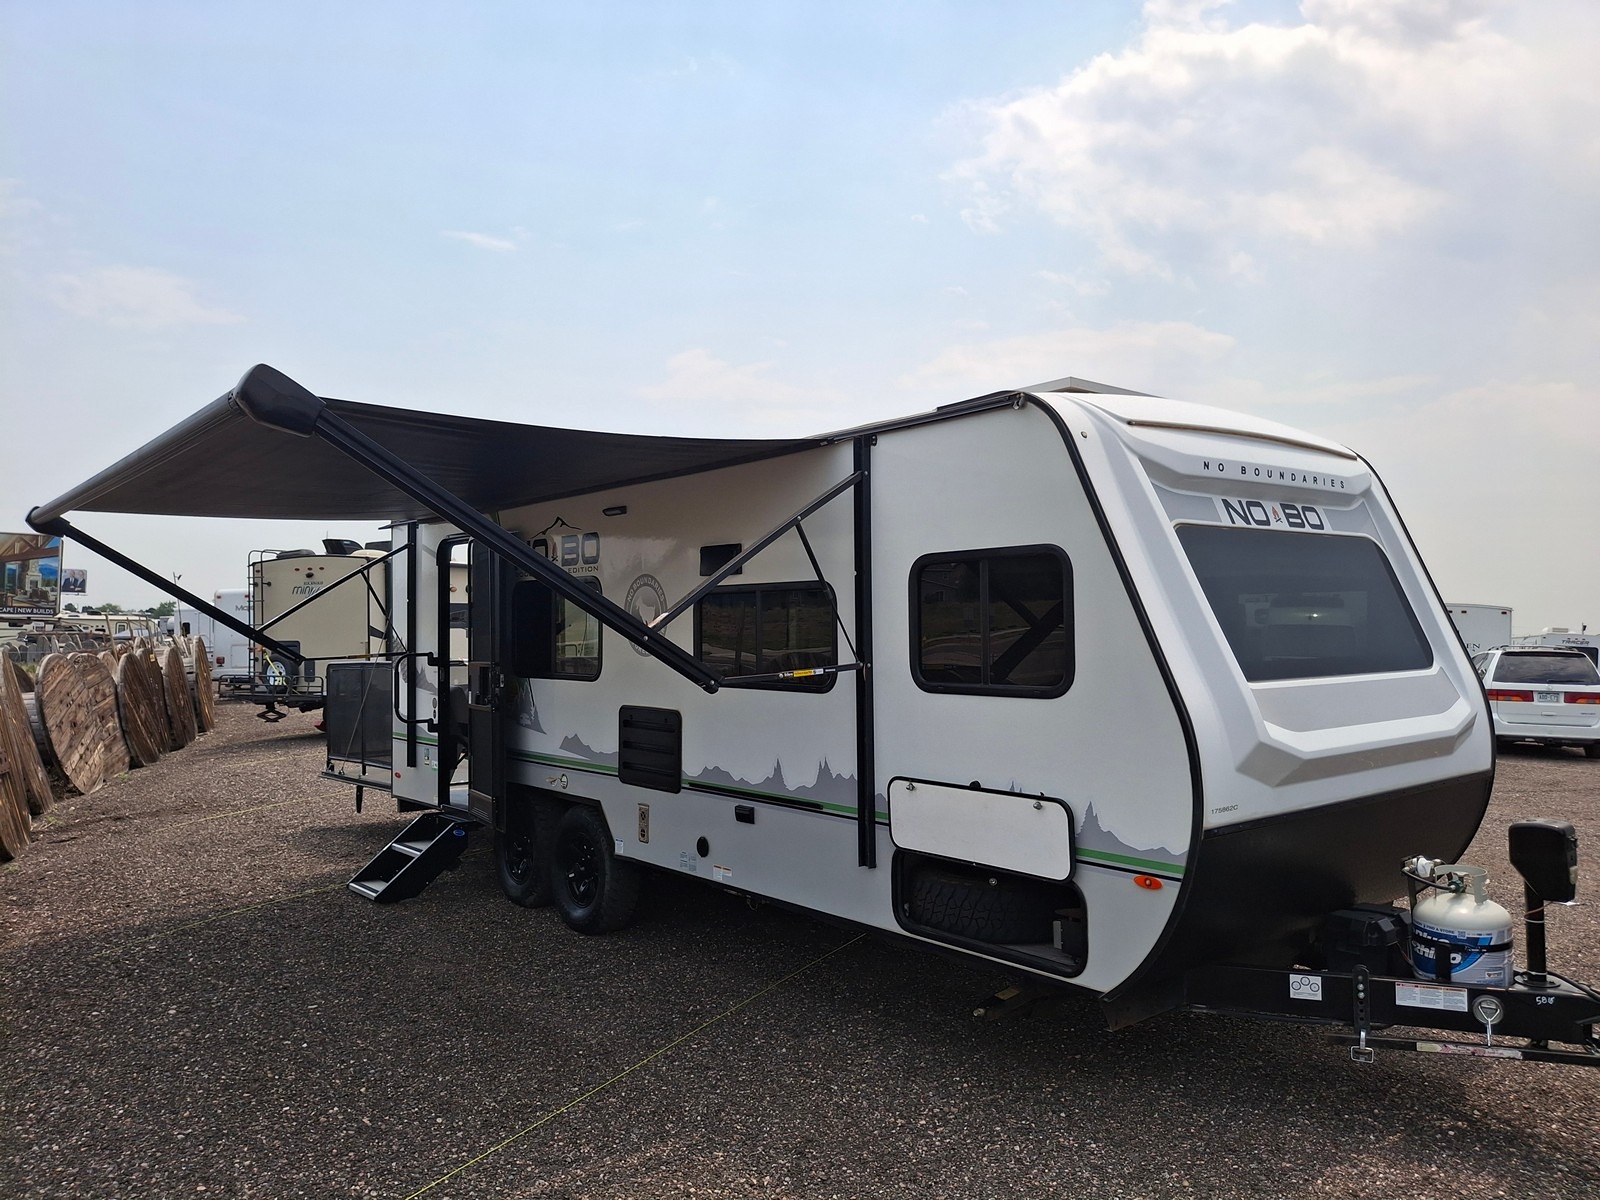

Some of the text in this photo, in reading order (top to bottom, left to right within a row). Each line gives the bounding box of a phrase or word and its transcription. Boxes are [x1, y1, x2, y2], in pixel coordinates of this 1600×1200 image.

[1203, 460, 1346, 490] NO BOUNDARIES
[567, 565, 599, 574] EDITION
[33, 607, 54, 615] BUILDS
